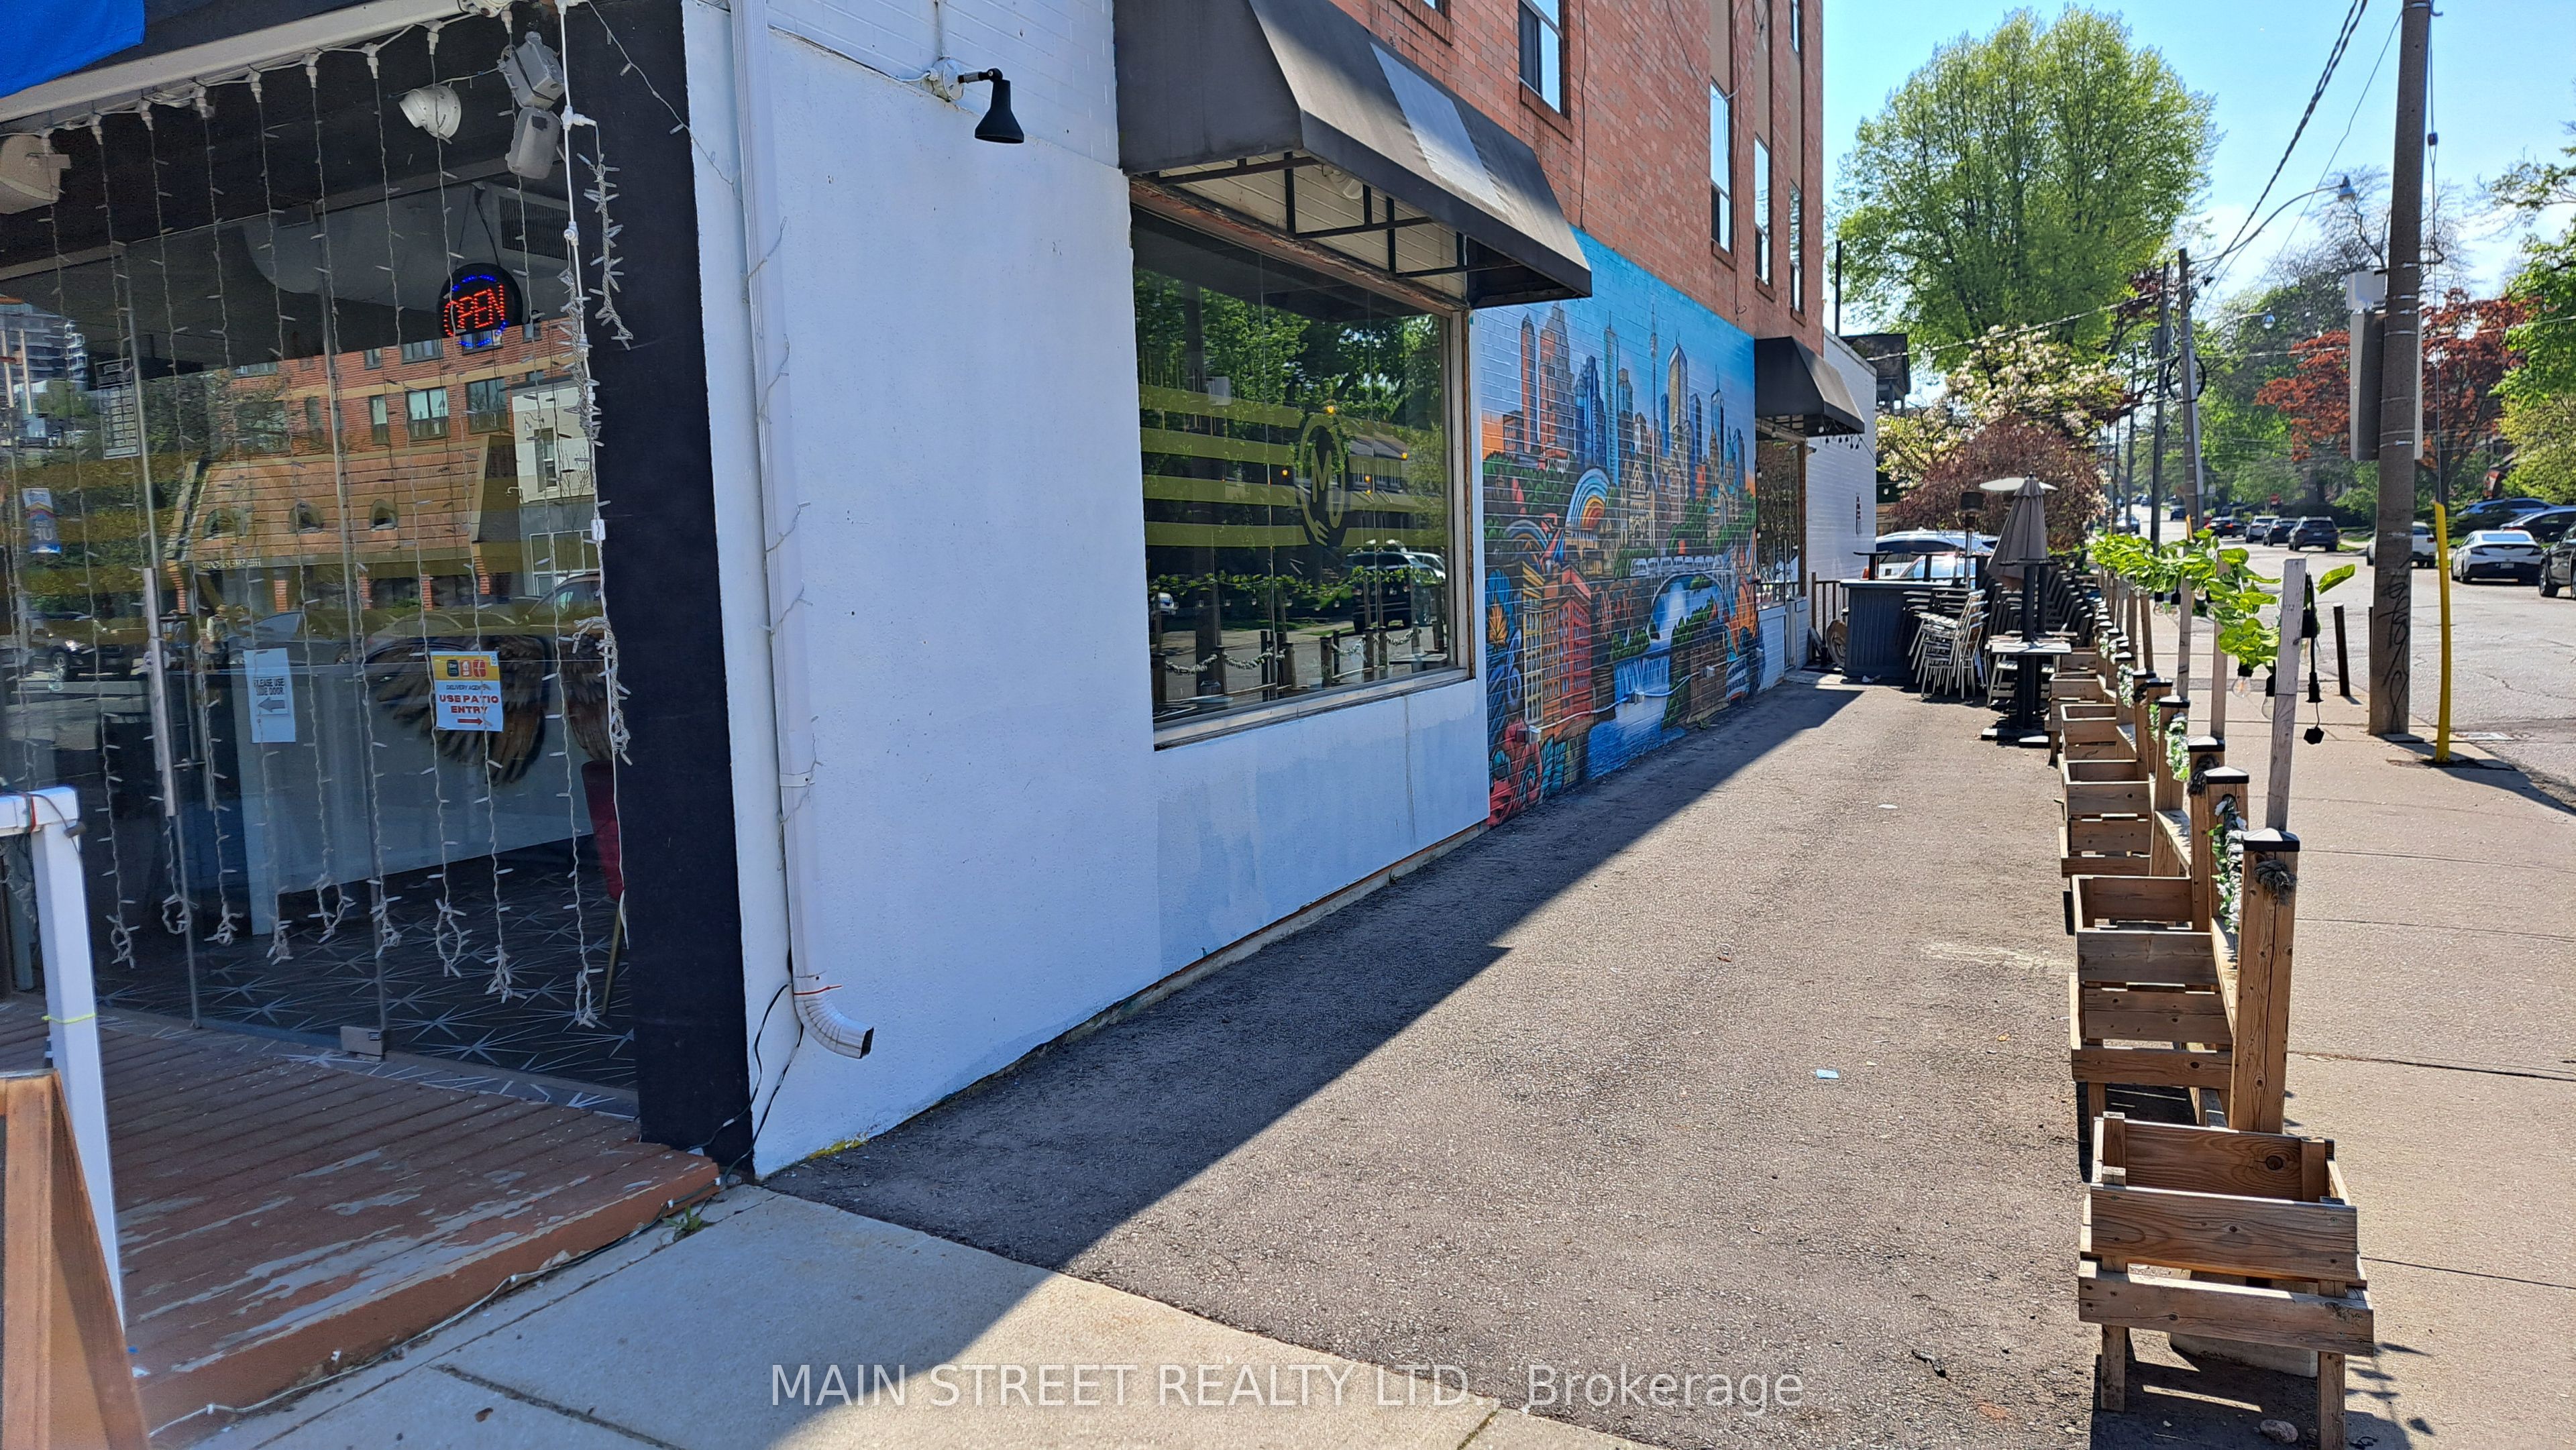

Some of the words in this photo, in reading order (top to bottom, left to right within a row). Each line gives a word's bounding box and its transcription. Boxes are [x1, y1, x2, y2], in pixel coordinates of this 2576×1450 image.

[443, 283, 504, 337] OPEN
[273, 678, 285, 686] USE
[268, 687, 285, 695] DOOR
[463, 695, 499, 704] PATIO
[450, 705, 488, 714] ENTRY
